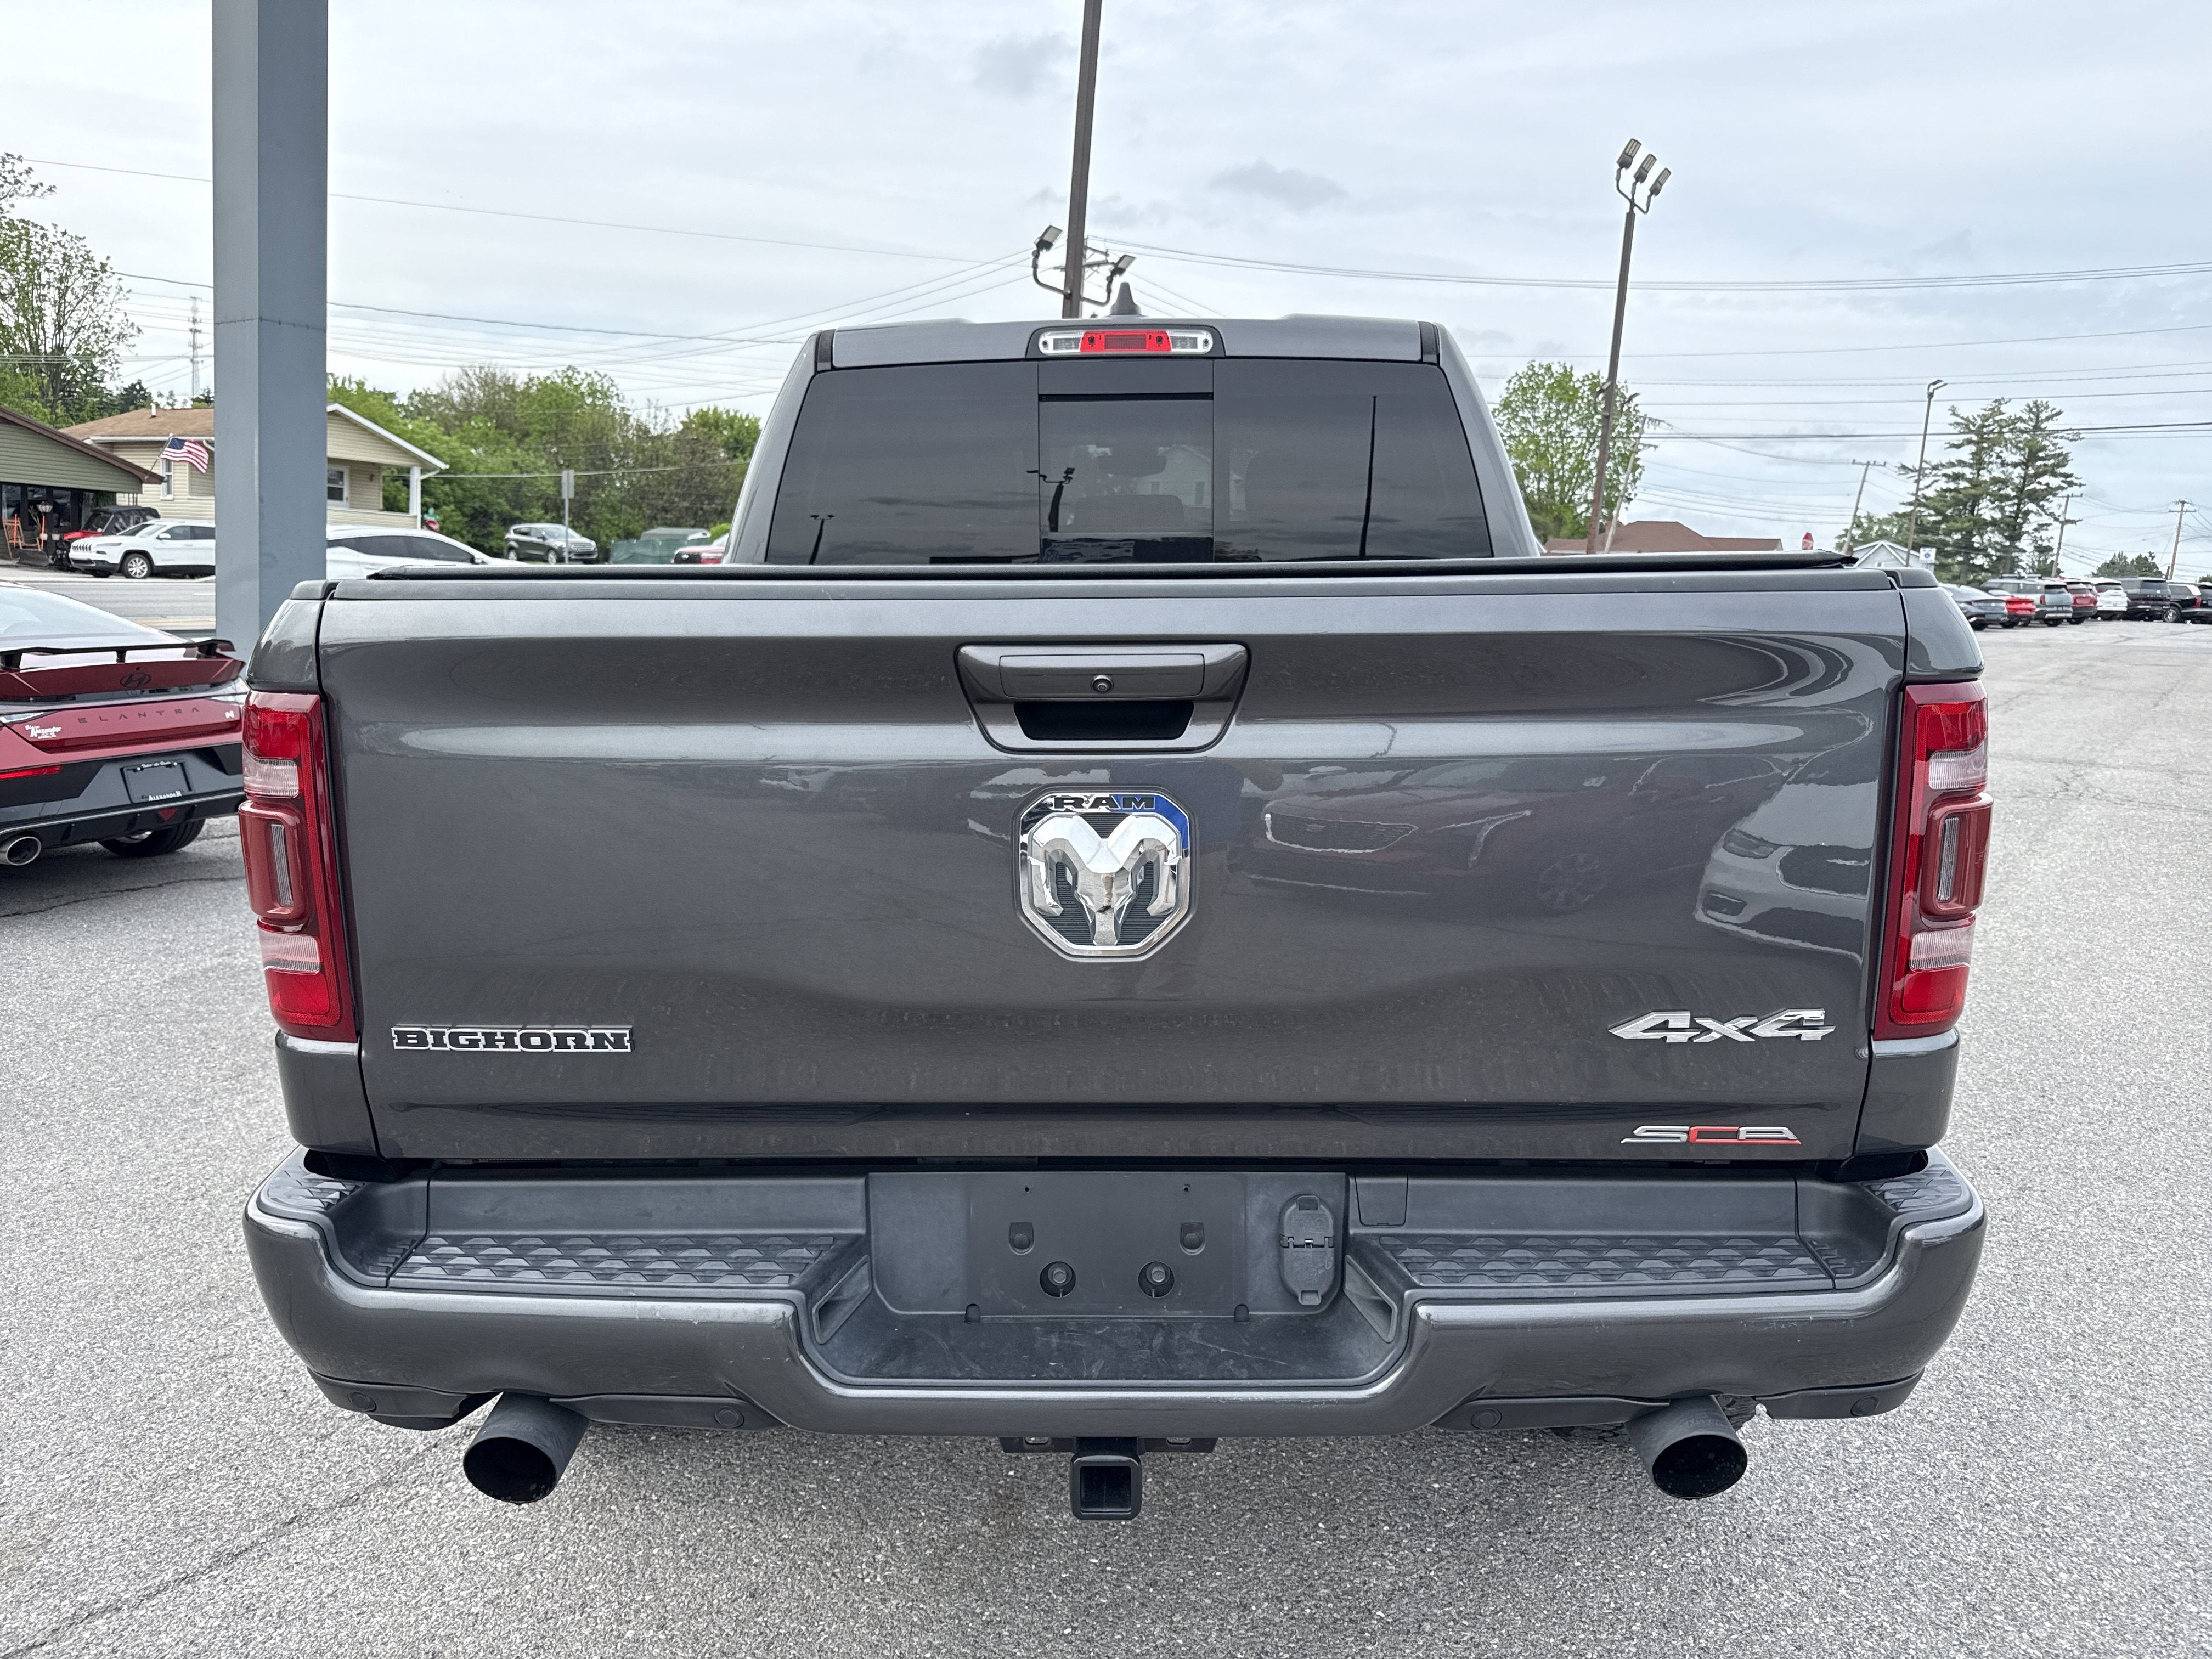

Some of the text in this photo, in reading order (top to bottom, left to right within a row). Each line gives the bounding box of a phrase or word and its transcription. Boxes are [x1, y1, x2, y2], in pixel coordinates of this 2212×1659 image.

[78, 707, 200, 724] ELANTRA
[225, 710, 235, 719] N
[1053, 797, 1154, 810] RAM
[391, 1025, 633, 1053] BIGHORN
[1620, 1125, 1802, 1145] SCA
